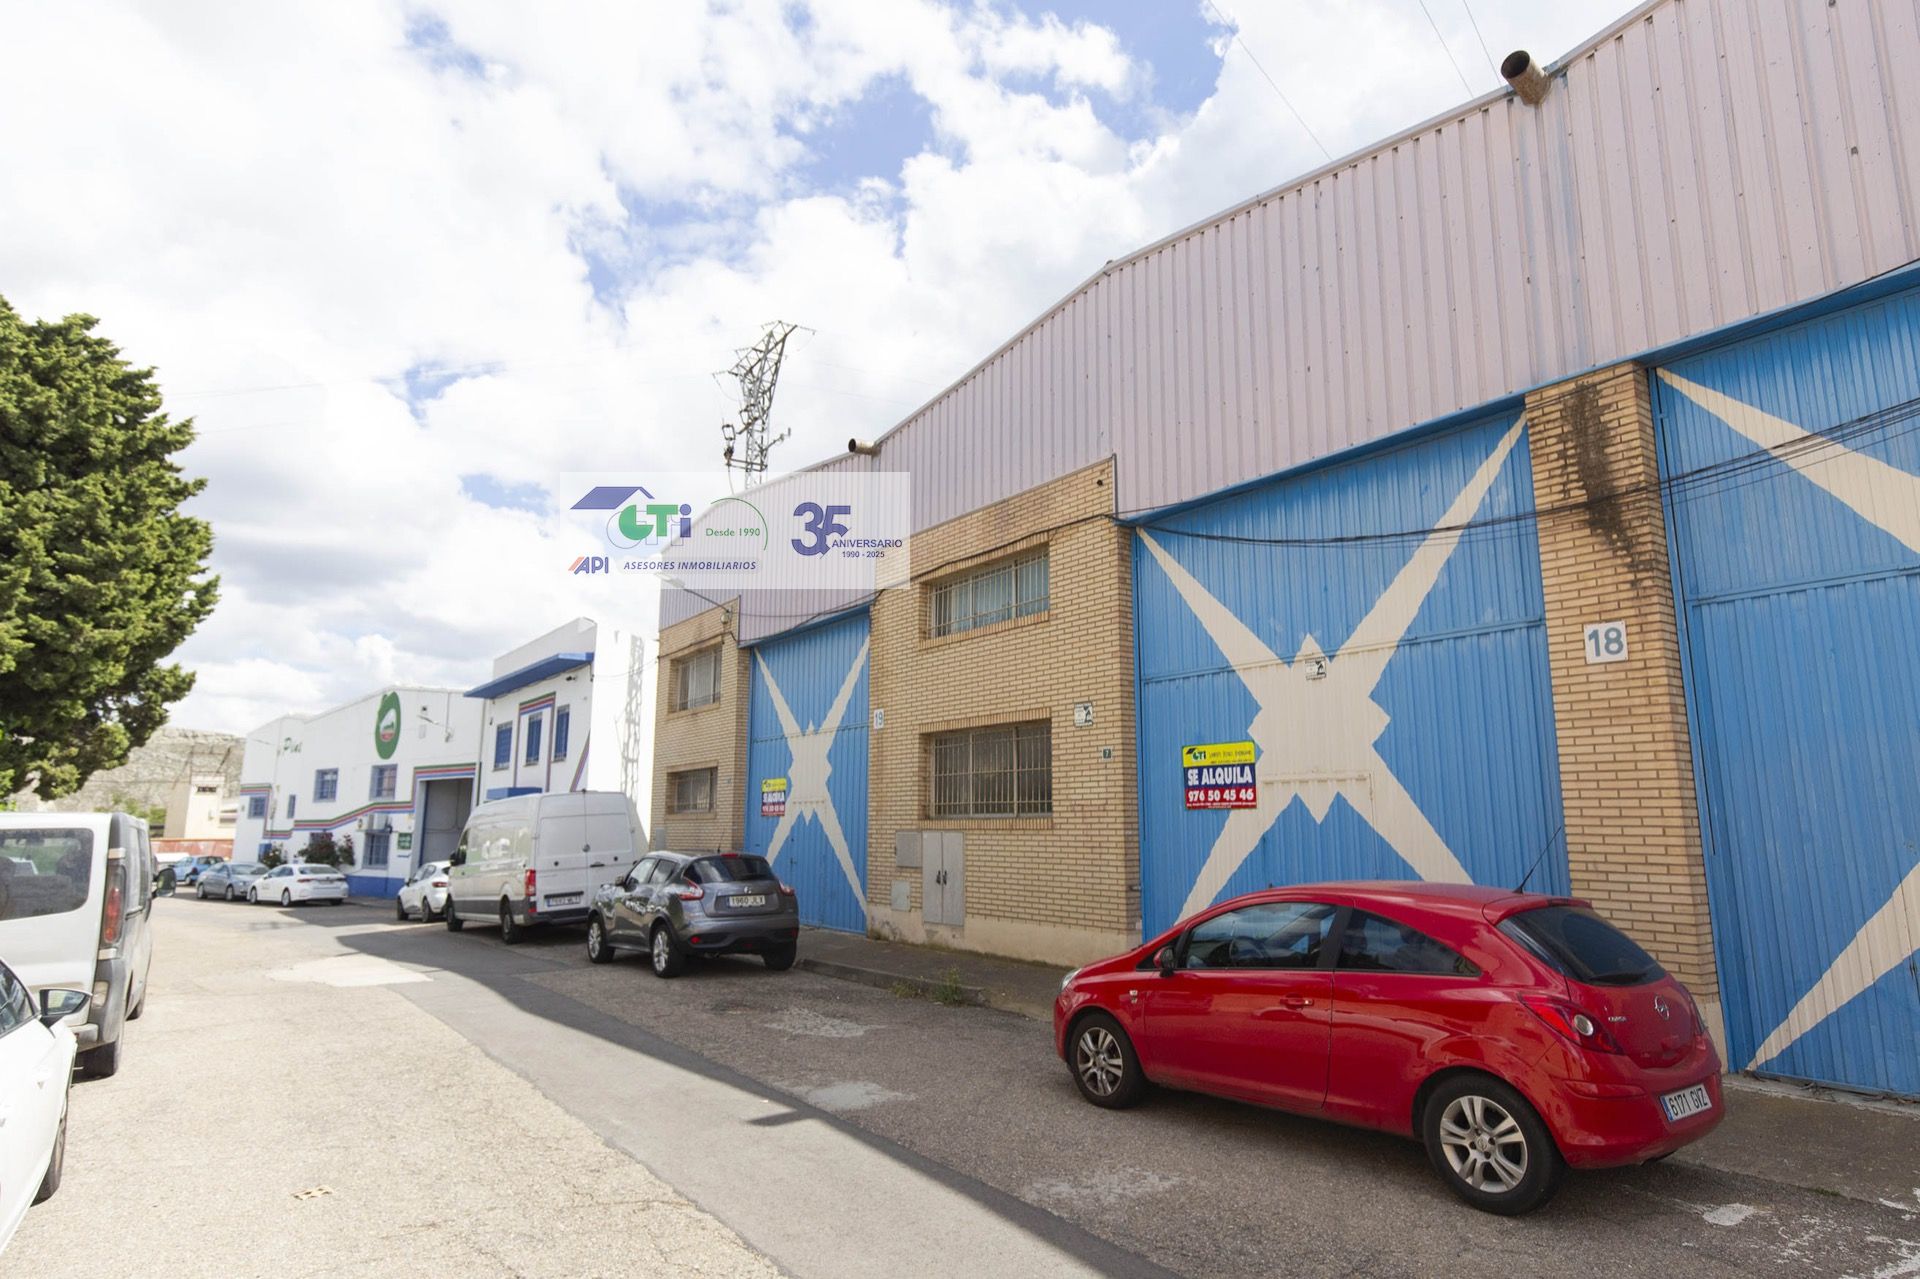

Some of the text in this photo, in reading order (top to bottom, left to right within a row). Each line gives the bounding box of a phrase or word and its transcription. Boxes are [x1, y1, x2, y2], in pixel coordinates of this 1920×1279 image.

[1588, 626, 1624, 657] 18
[1187, 766, 1253, 786] SE ALQUILA
[1188, 788, 1255, 803] 976 50 45 46
[1668, 1087, 1708, 1117] 6171 GVZ
